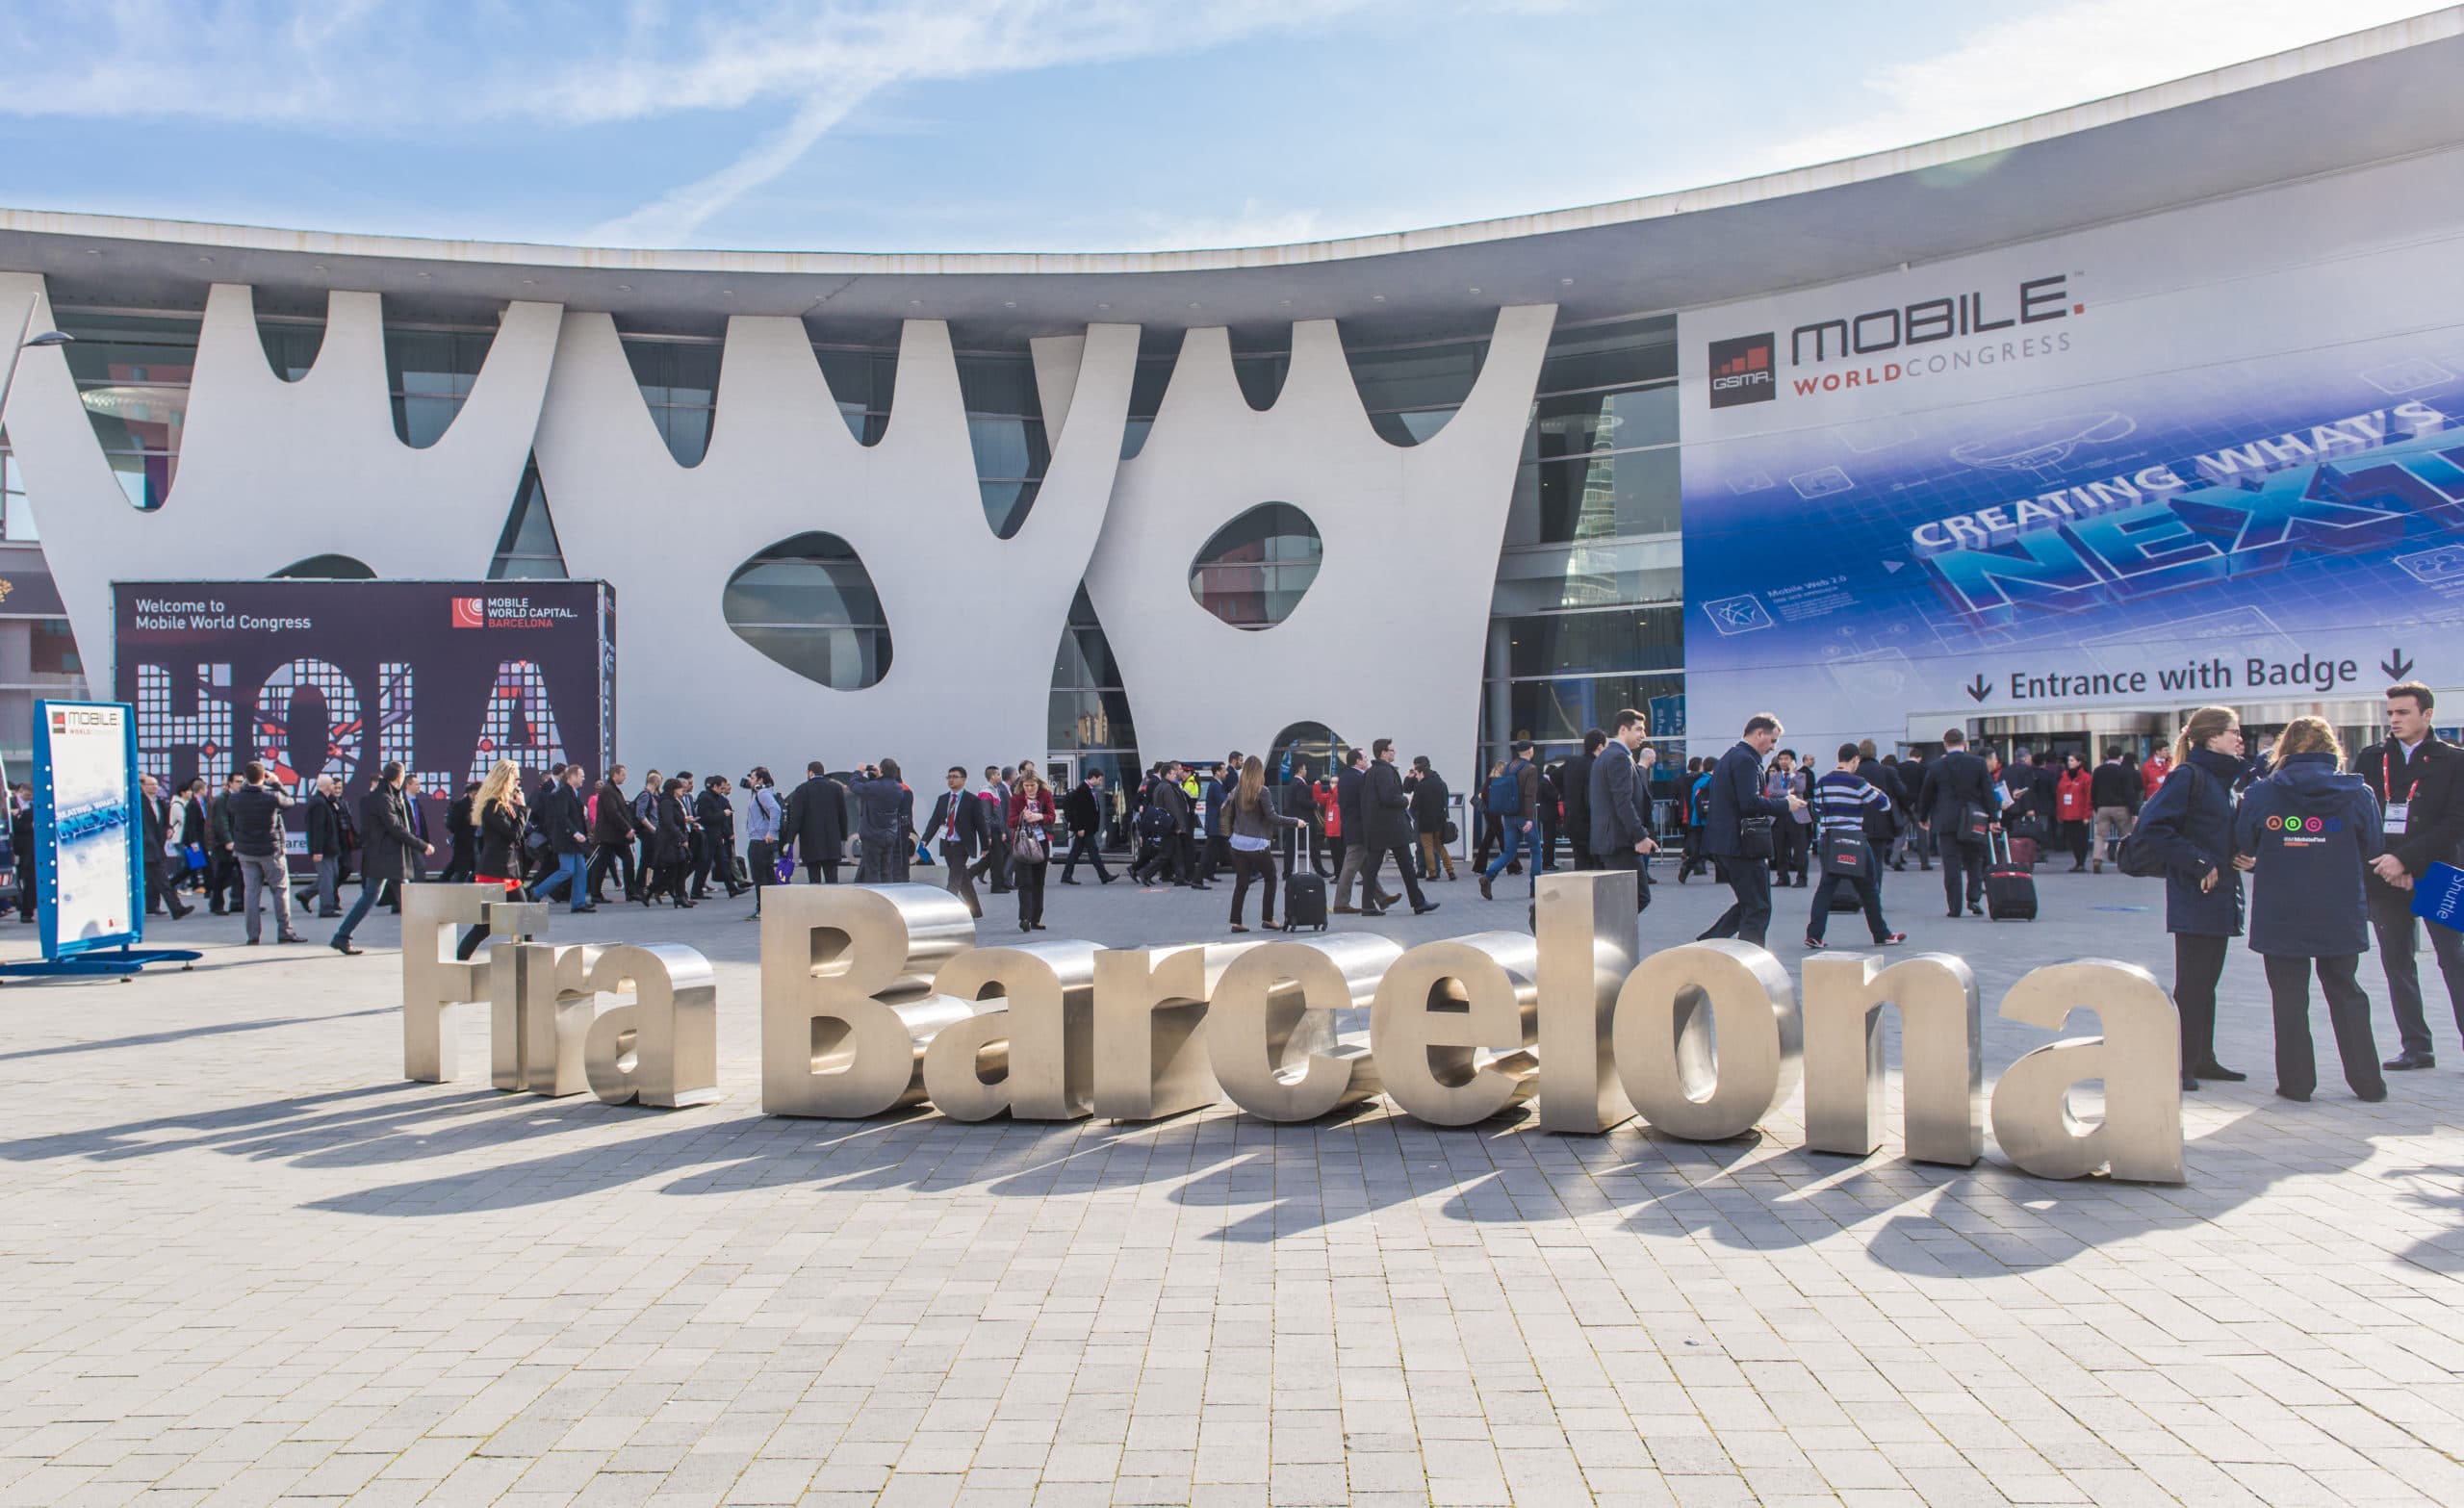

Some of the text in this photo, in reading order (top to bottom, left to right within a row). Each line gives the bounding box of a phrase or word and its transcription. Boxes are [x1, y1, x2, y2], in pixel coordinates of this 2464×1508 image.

[1712, 371, 1769, 391] GSMA
[1912, 400, 2444, 549] CREATING WHAT'S
[1929, 426, 2464, 616] NEXT
[136, 599, 225, 613] Welcome to
[487, 598, 528, 608] MOBILE
[487, 608, 574, 618] WORLD CAPITAL
[136, 615, 312, 632] Mobile World Congress
[488, 619, 553, 628] BARCELONA
[2011, 653, 2358, 700] Entrance with Badge
[138, 658, 570, 804] HOLA
[2436, 874, 2464, 920] Shuttle
[401, 869, 2183, 1184] Fira Barcelona
